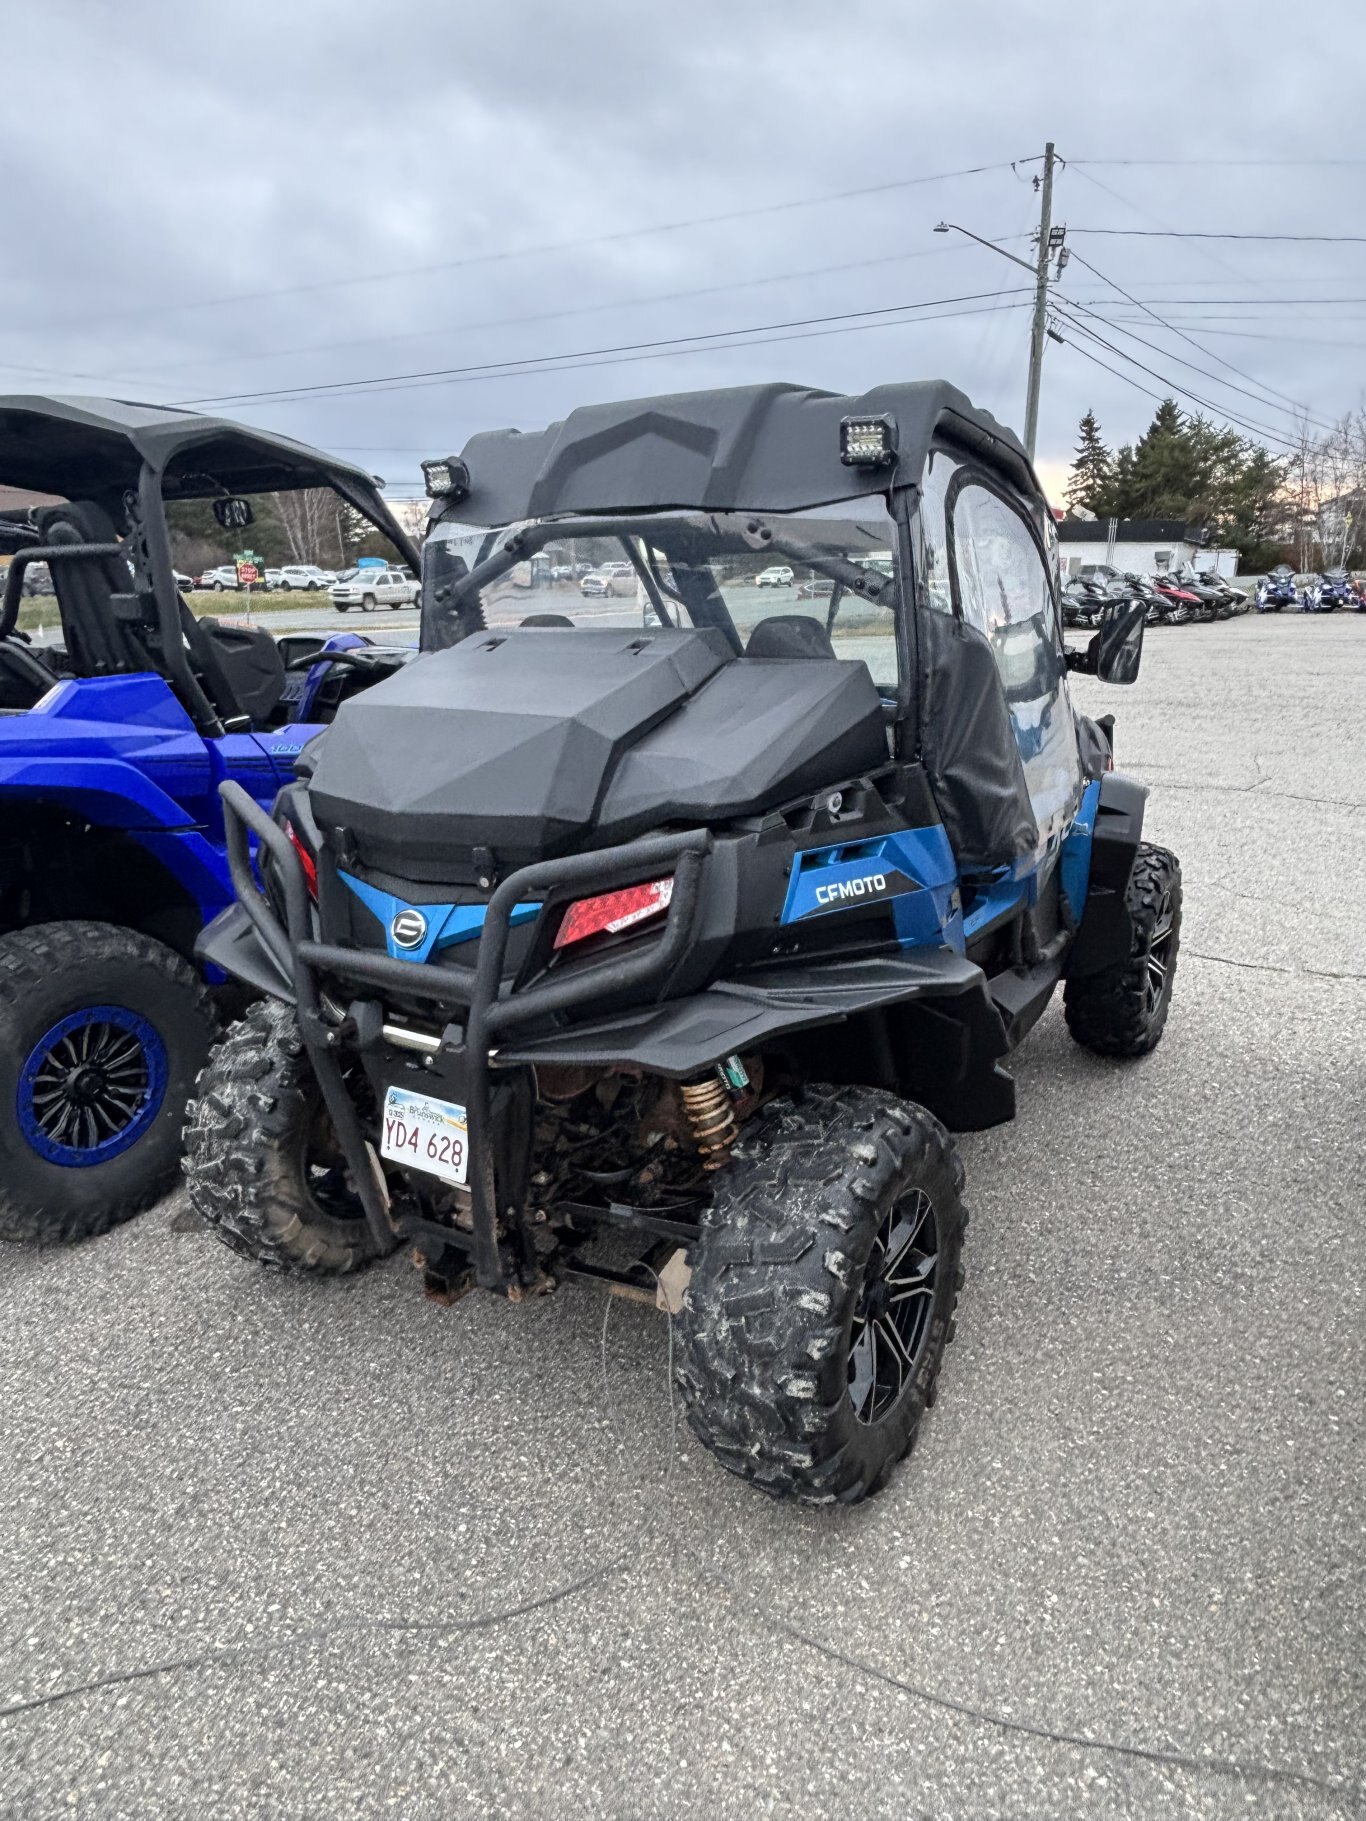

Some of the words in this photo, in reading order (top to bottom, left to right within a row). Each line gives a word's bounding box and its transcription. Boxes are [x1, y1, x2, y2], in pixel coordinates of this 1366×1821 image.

[815, 874, 886, 904] CFMOTO
[386, 1117, 419, 1153] YD4
[427, 1133, 463, 1167] 628
